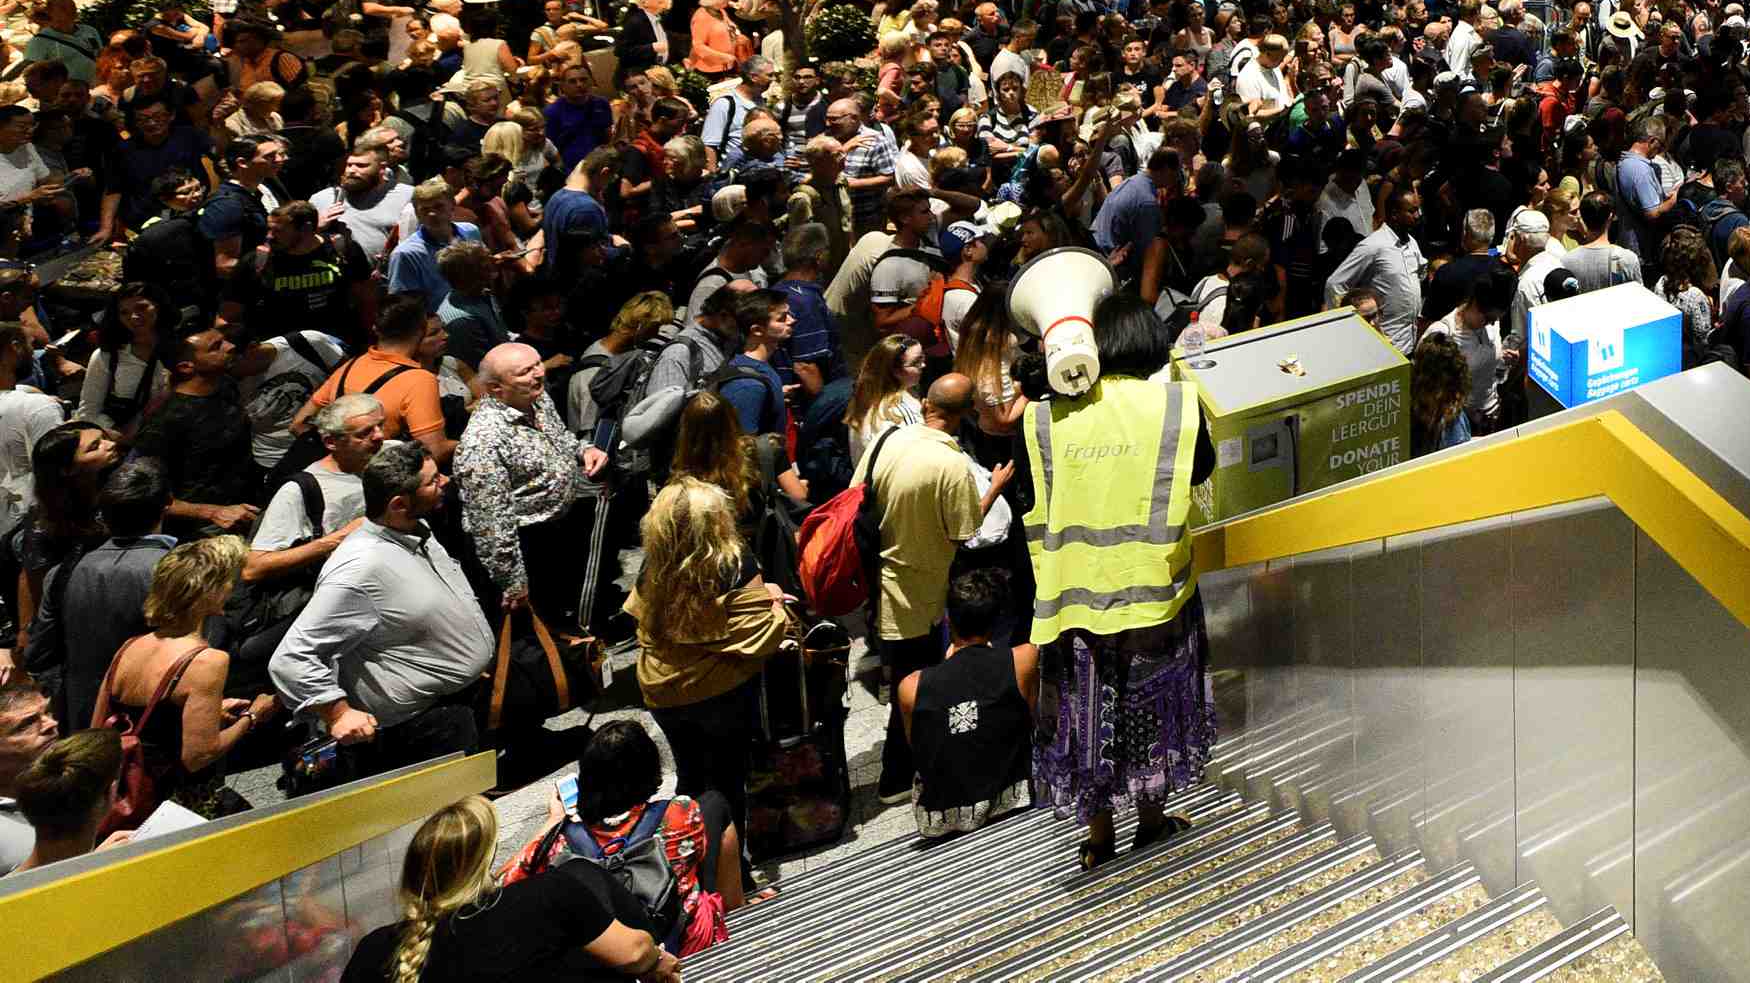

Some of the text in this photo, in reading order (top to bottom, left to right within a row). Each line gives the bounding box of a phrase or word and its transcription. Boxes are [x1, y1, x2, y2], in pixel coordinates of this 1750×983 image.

[1335, 379, 1400, 409] SPENDE
[1363, 394, 1400, 417] DEIN
[1332, 410, 1400, 443] LEERGUT
[1329, 436, 1400, 470] DONATE
[1357, 452, 1400, 473] YOUR
